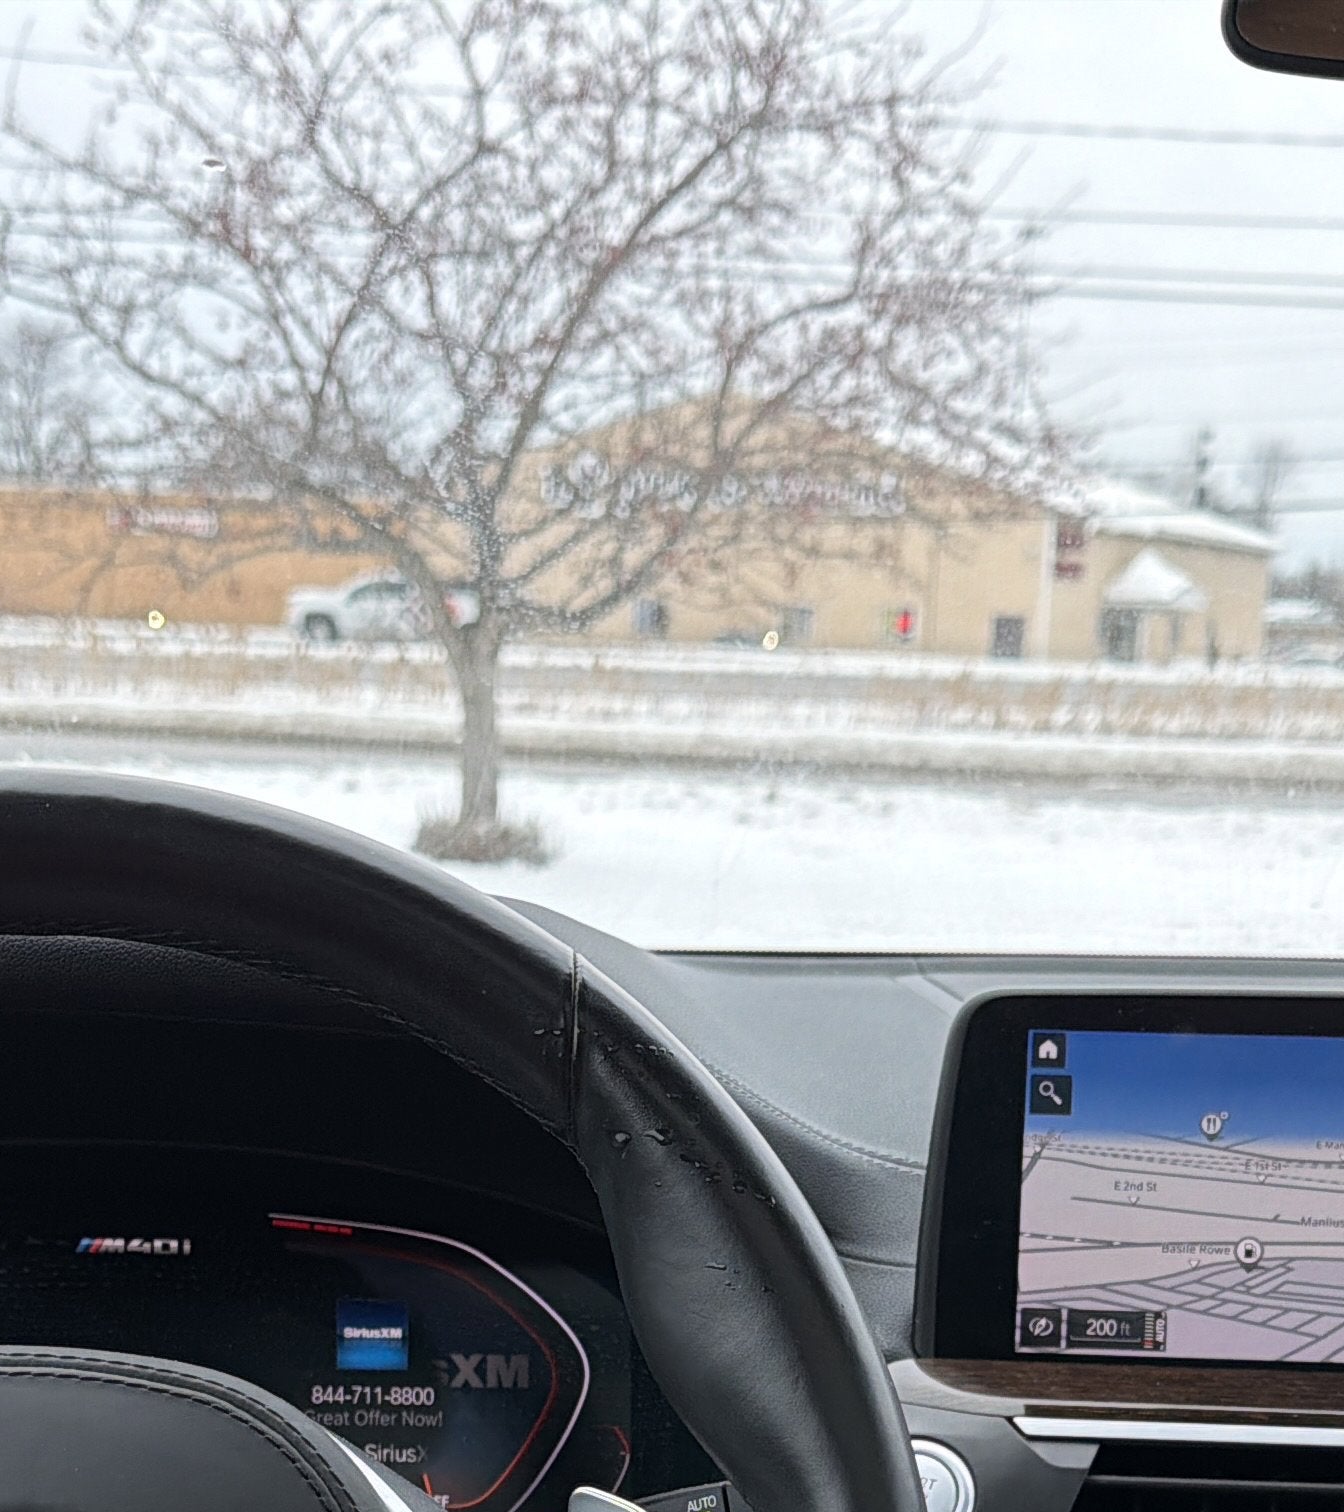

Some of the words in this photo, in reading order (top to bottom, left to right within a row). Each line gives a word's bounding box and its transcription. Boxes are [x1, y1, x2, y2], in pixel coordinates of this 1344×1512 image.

[1114, 1181, 1121, 1191] E
[1123, 1181, 1143, 1192] 2nd
[1145, 1182, 1157, 1192] St
[1161, 1242, 1192, 1255] Basile
[1195, 1244, 1231, 1256] Rowe
[343, 1326, 403, 1339] SiriusXM
[1086, 1318, 1117, 1337] 200
[1119, 1323, 1131, 1337] ft
[311, 1385, 435, 1406] 844-711-8800
[354, 1410, 396, 1427] Offer
[401, 1410, 443, 1428] Now!
